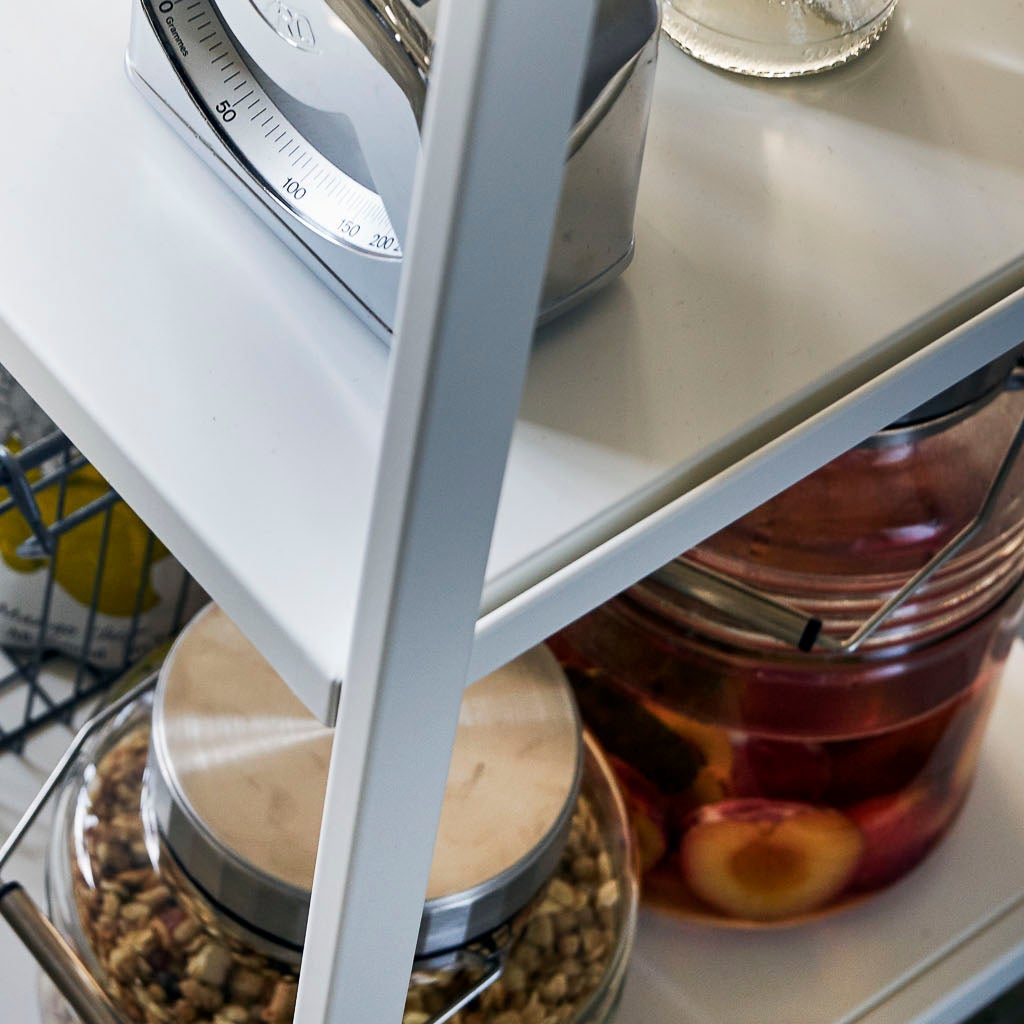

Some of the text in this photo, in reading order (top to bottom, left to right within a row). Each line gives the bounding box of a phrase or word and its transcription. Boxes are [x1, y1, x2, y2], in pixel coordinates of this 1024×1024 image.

[158, 0, 189, 57] 0 Grammes
[215, 99, 237, 123] 50
[282, 176, 307, 201] 100
[337, 218, 361, 238] 150
[368, 233, 395, 250] 200
